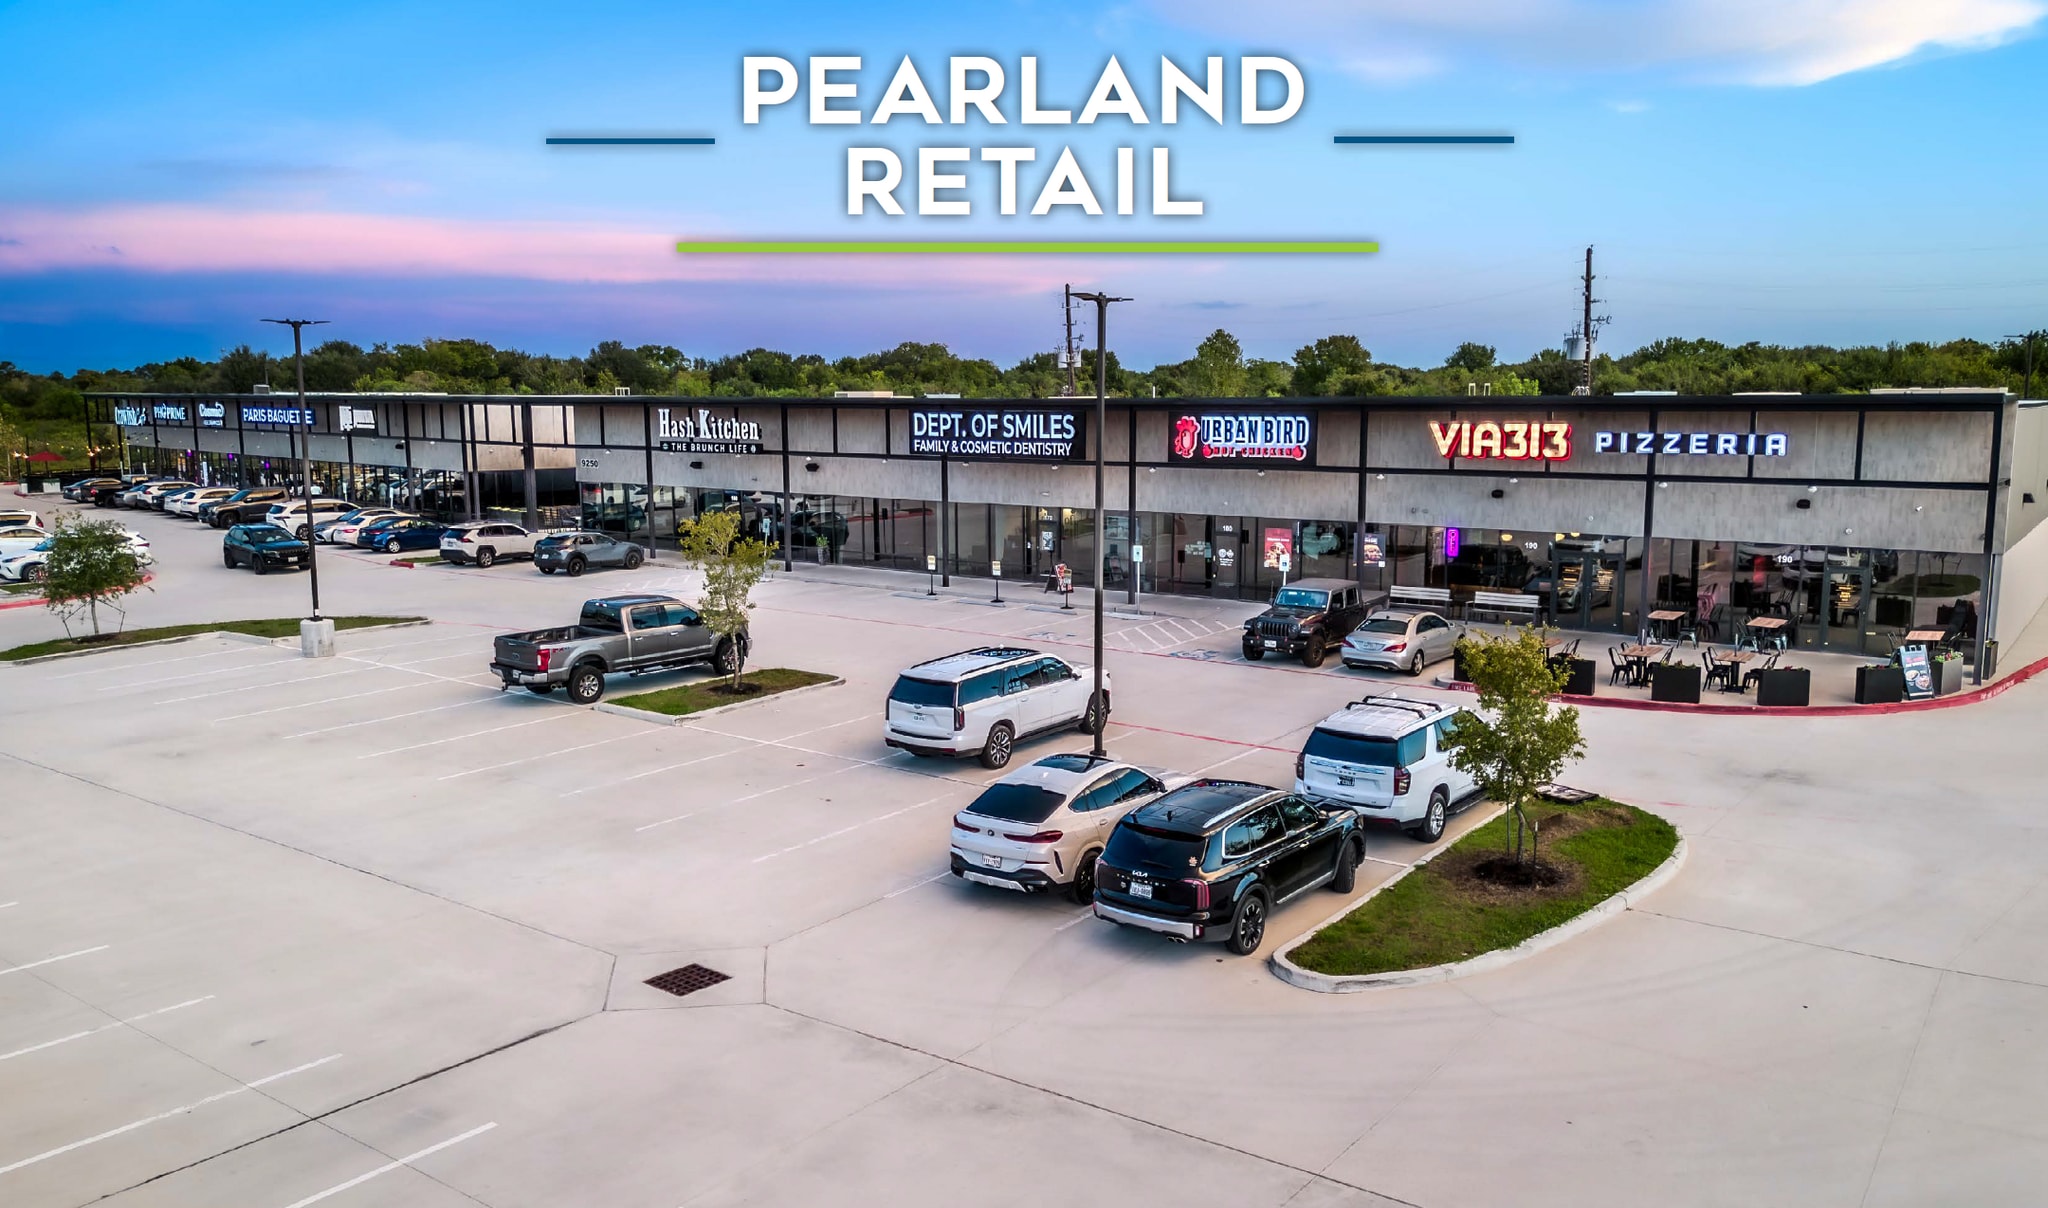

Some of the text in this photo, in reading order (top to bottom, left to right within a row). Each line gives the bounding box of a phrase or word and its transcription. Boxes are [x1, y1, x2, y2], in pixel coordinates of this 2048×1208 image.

[166, 406, 186, 420] PRIME
[243, 408, 313, 425] PARIS BAGUETE
[658, 408, 760, 440] Hash Kitchen
[913, 412, 1076, 440] DEPT. OF SMILES
[1201, 416, 1310, 446] URBAN BIRD
[671, 442, 748, 453] THE BRUNCH LIFE
[914, 440, 1073, 456] FAMILY & COSMETIC DENTISTRY
[1428, 421, 1573, 462] VIA313
[1595, 431, 1787, 457] PIZZERIA
[1213, 446, 1294, 458] HOT CHICKEN
[581, 459, 599, 468] 9250
[1525, 542, 1538, 550] 190
[1777, 555, 1793, 564] 190
